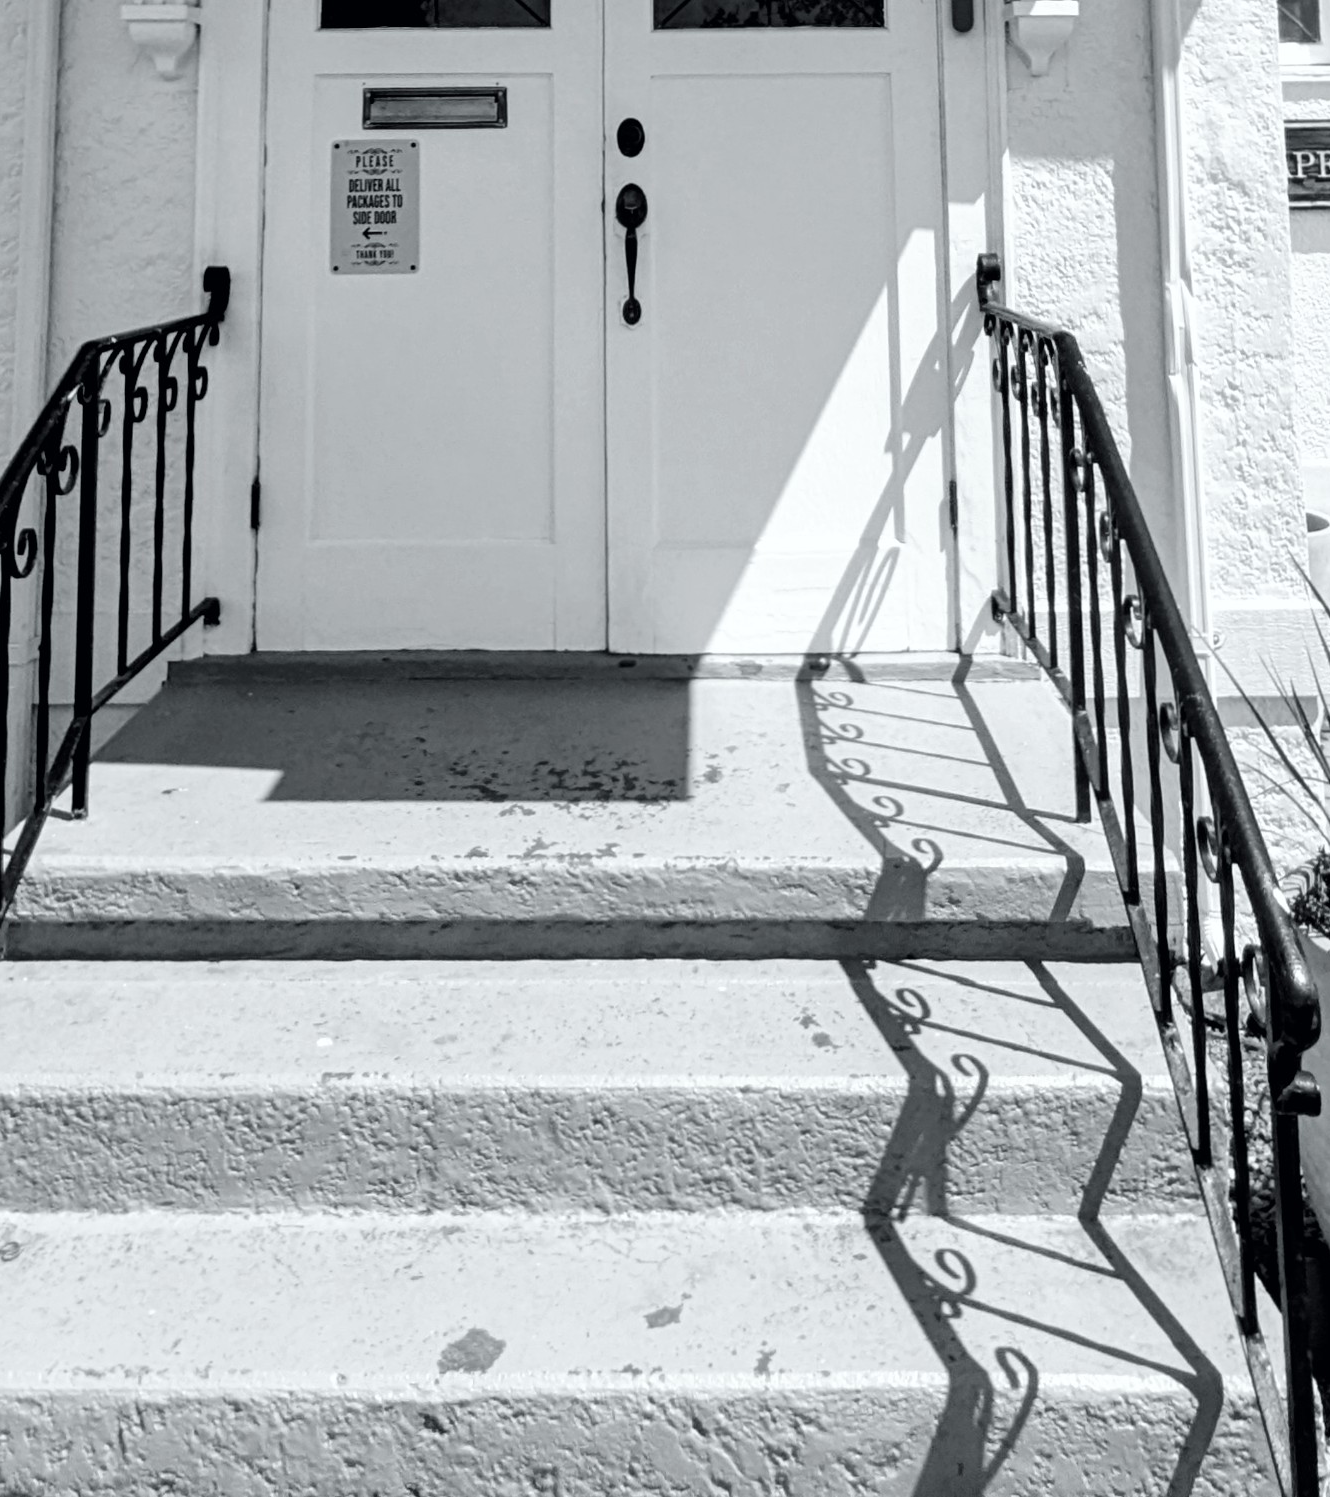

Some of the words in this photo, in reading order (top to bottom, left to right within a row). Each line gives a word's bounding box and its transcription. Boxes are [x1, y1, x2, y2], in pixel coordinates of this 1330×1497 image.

[356, 155, 394, 168] PLEASE
[349, 178, 383, 192] DELIVER
[385, 178, 401, 192] ALL
[346, 195, 390, 209] PACKAGES
[392, 194, 403, 208] TO
[353, 211, 372, 225] SIDE
[374, 211, 397, 224] DOOR
[356, 250, 376, 259] THANK
